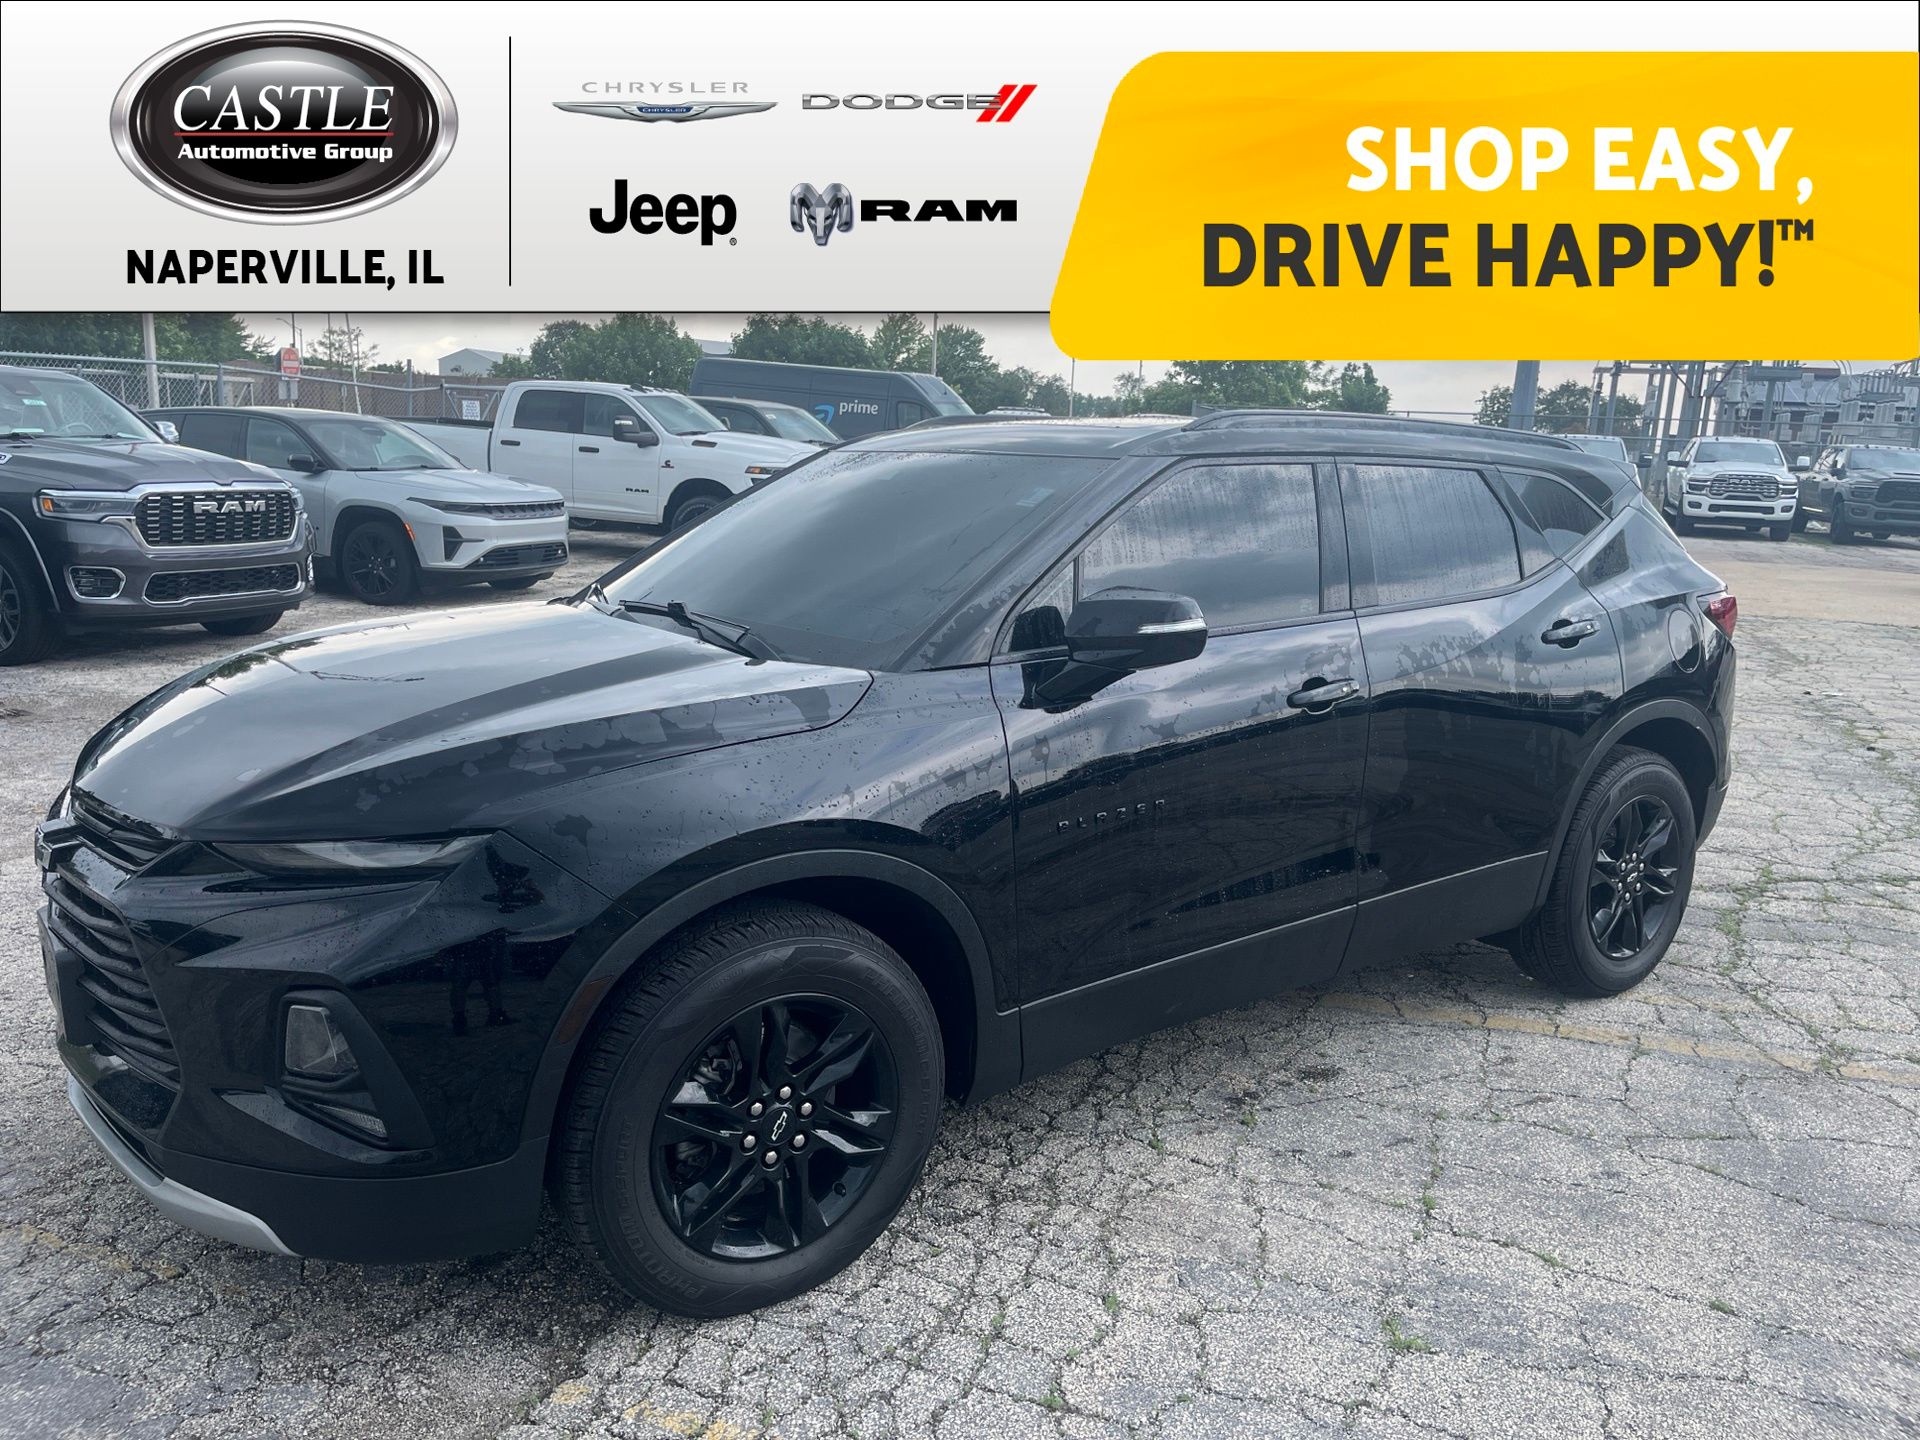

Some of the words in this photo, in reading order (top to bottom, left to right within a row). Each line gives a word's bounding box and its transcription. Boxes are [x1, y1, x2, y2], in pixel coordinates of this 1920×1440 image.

[839, 399, 879, 415] prime
[193, 500, 266, 514] RAM
[1057, 799, 1166, 833] BLAZER
